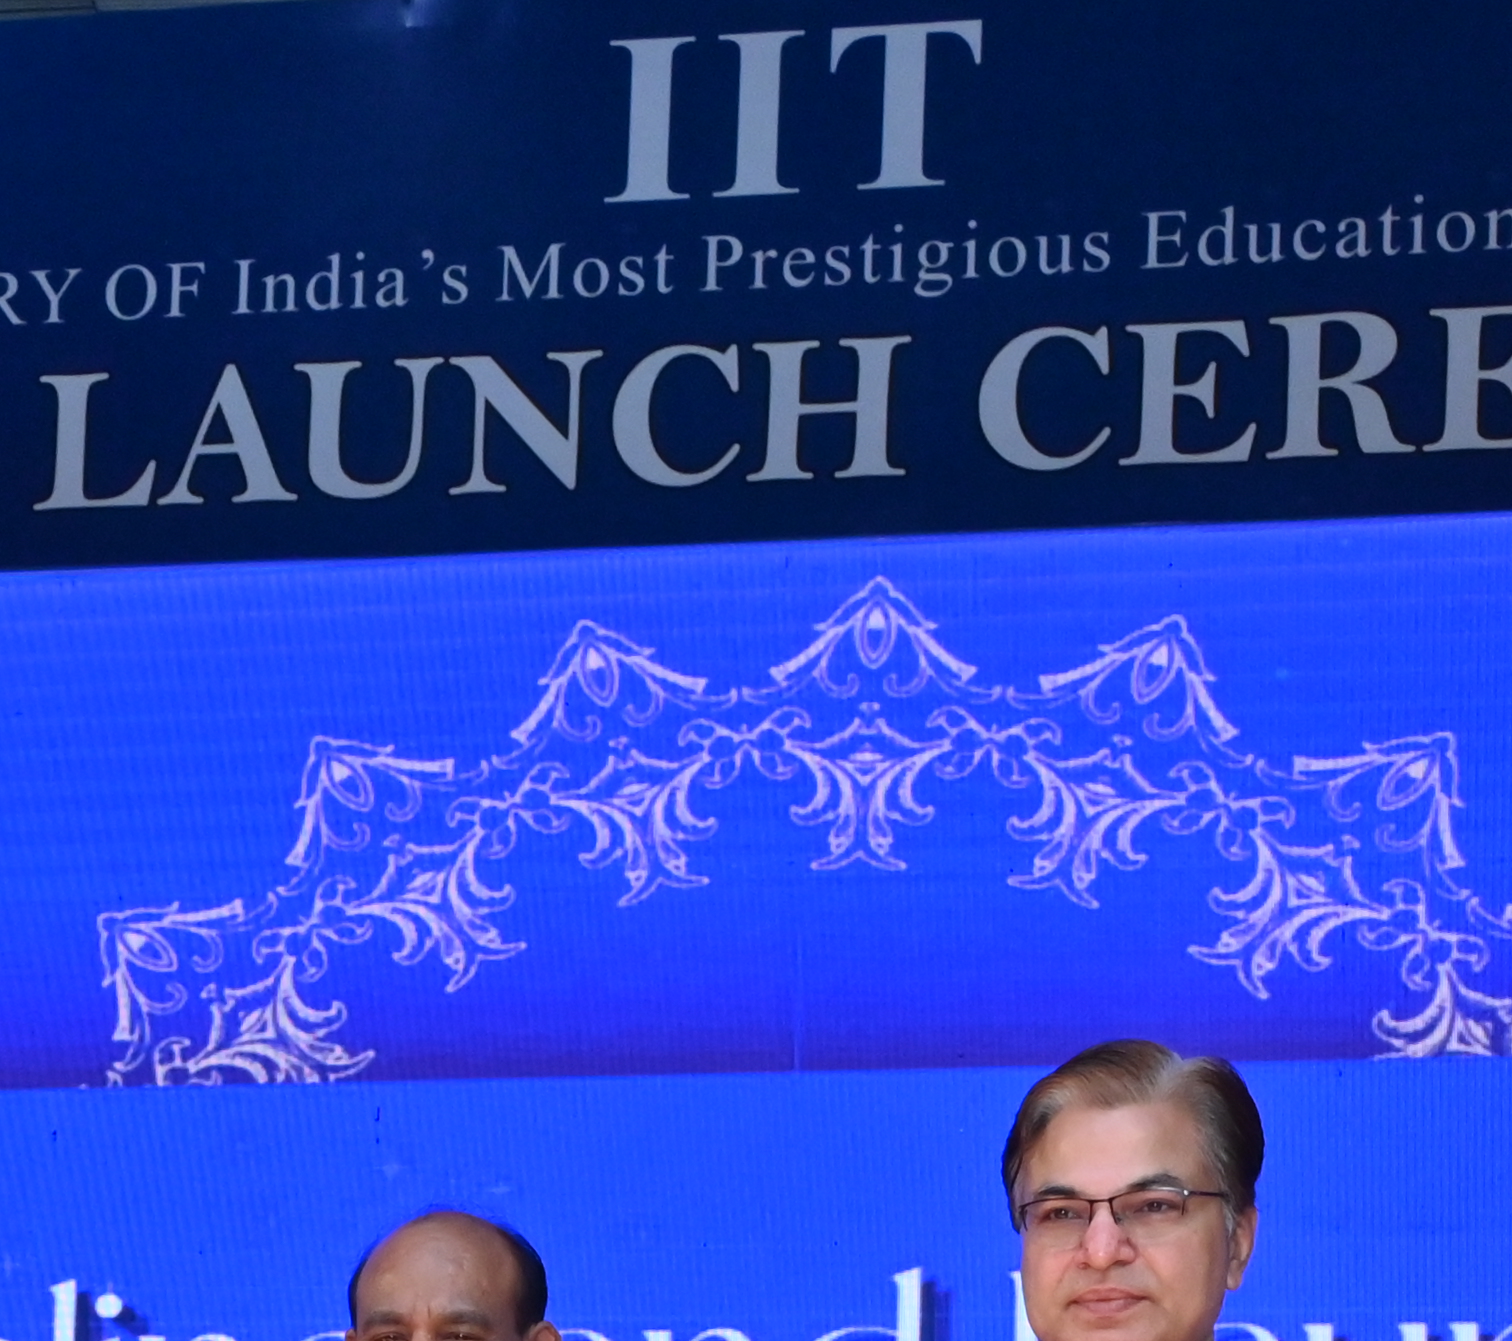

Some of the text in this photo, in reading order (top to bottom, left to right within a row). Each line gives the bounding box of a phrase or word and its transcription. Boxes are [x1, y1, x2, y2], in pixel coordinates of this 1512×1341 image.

[604, 19, 982, 202] IIT
[106, 262, 204, 320] OF
[233, 249, 468, 314] India’s
[497, 243, 673, 300] Most
[703, 220, 1110, 297] Prestigious
[33, 336, 911, 510] LAUNCH
